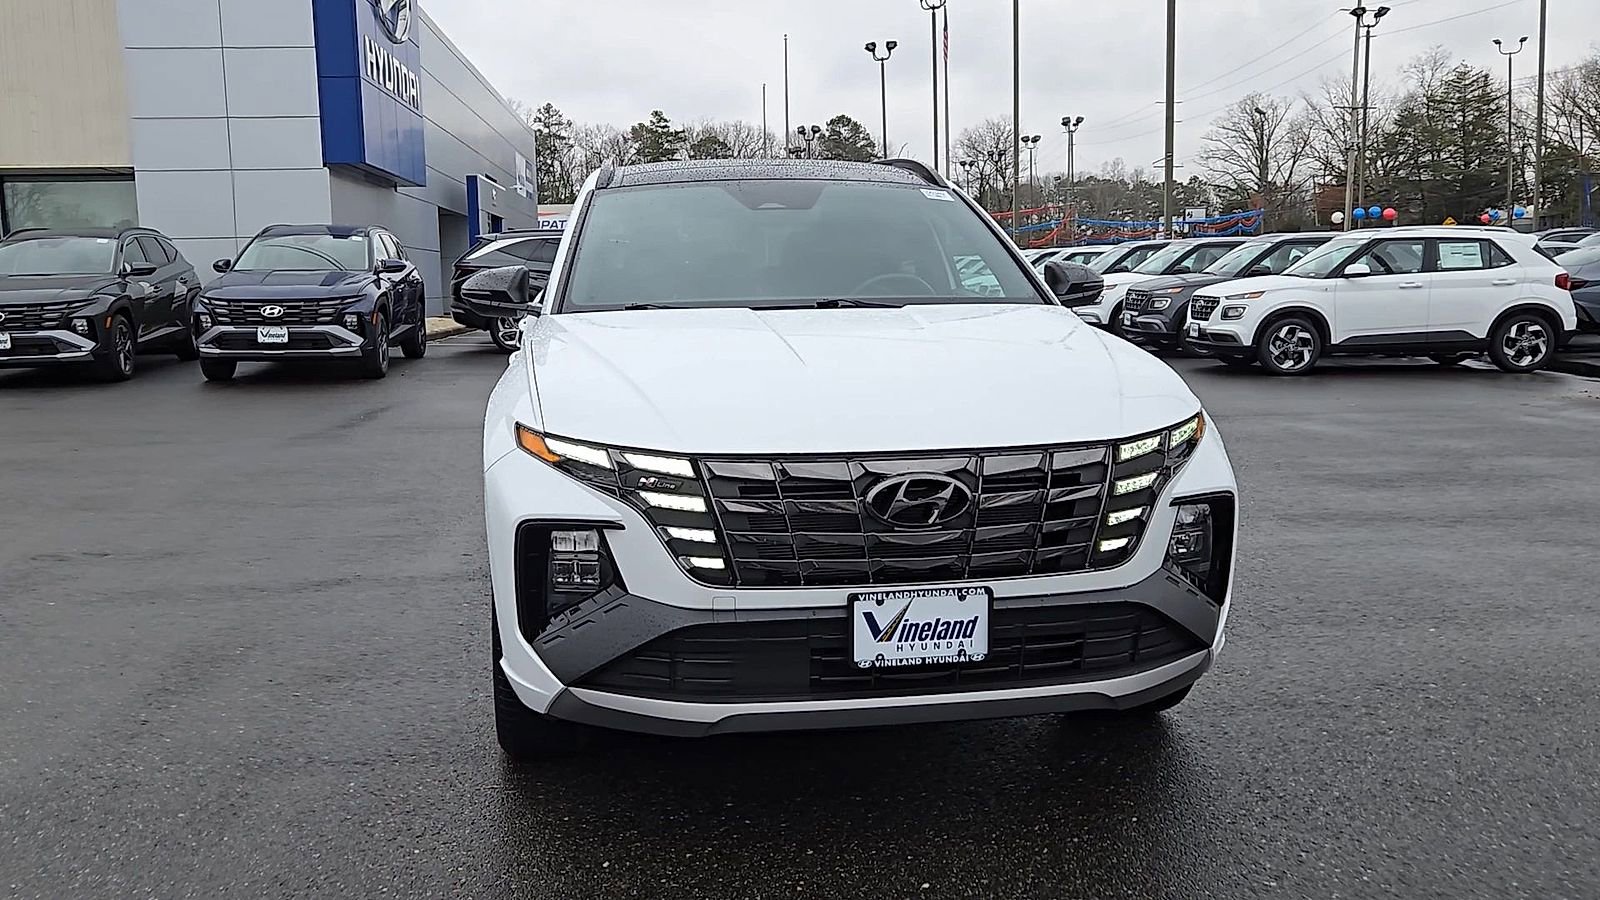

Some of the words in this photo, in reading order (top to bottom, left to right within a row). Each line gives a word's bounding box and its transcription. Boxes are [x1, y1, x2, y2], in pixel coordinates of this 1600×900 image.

[363, 33, 420, 110] HYUNDAI
[538, 220, 567, 229] PAT
[858, 588, 986, 601] VINELANDHYUNDAI.COM
[862, 597, 979, 642] Vineland
[896, 640, 973, 652] HYUNDAI
[874, 657, 922, 668] VINELAND
[925, 655, 969, 665] HYUNDAI
